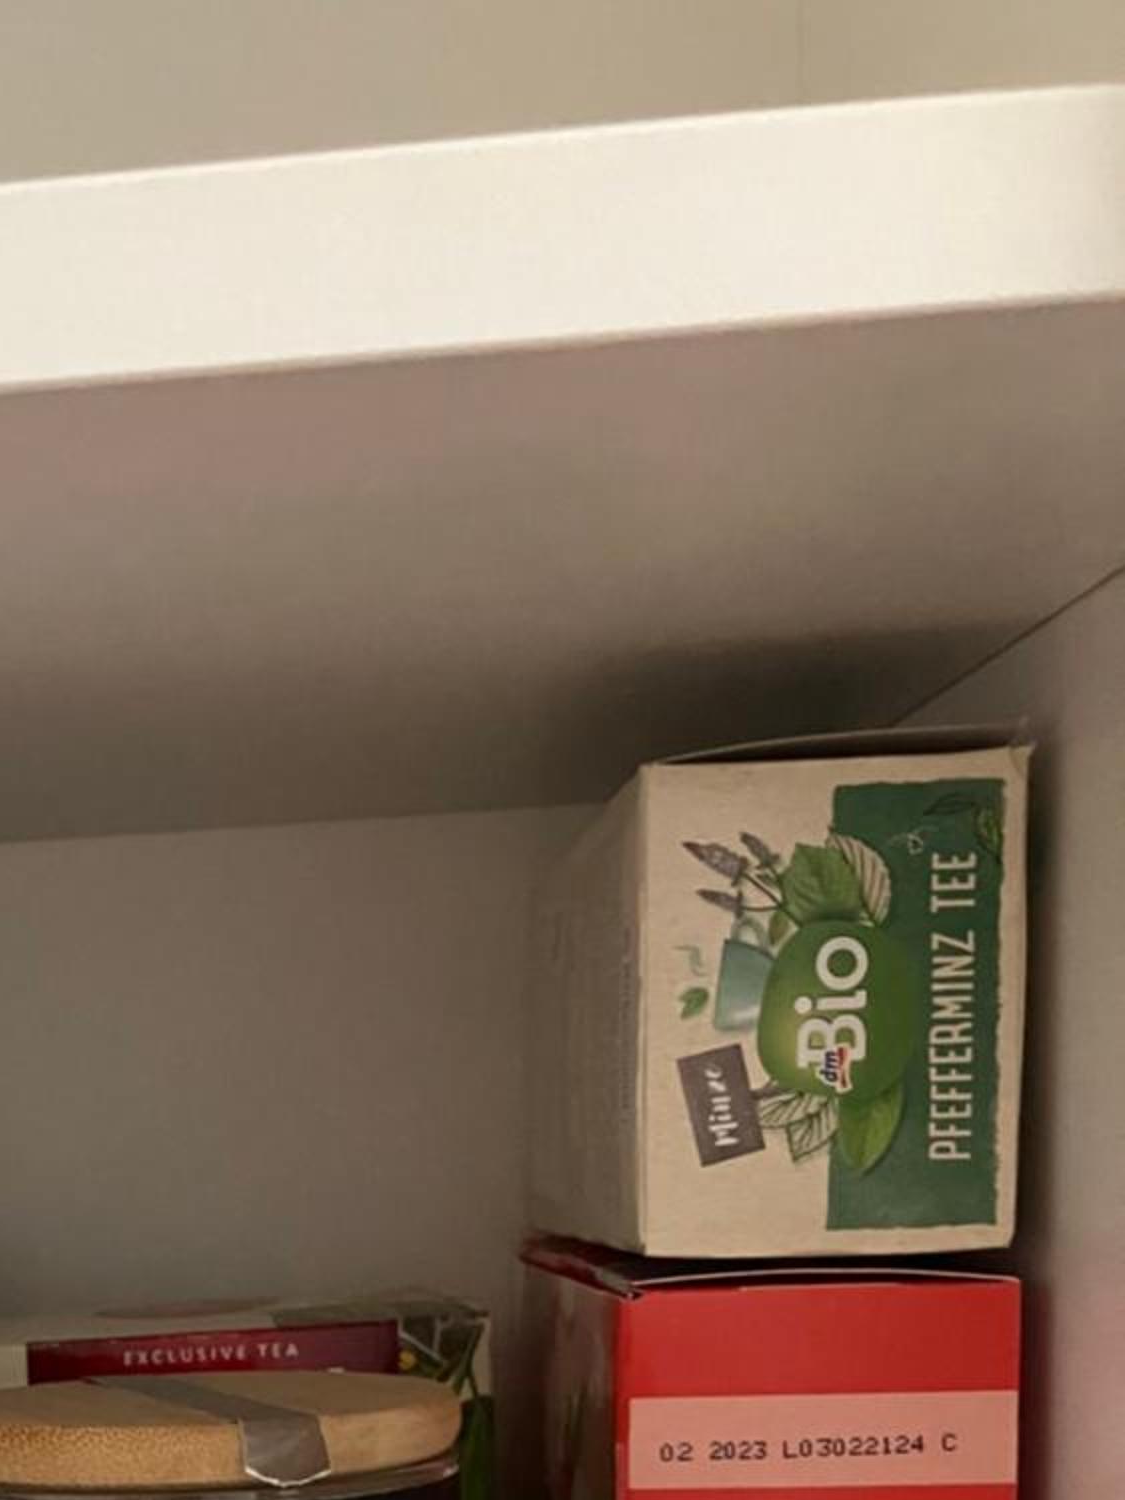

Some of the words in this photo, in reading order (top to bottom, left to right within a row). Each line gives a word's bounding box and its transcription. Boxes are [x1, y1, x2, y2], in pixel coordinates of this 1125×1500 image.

[930, 850, 977, 914] TEE
[795, 933, 870, 1071] Bio
[928, 929, 976, 1162] PFEFFERMINZ
[122, 1343, 248, 1368] EXCLUSIVE
[256, 1341, 300, 1360] TEA
[659, 1440, 695, 1463] 02
[708, 1439, 768, 1462] 2023
[782, 1433, 926, 1460] L03022124
[941, 1432, 958, 1452] C
